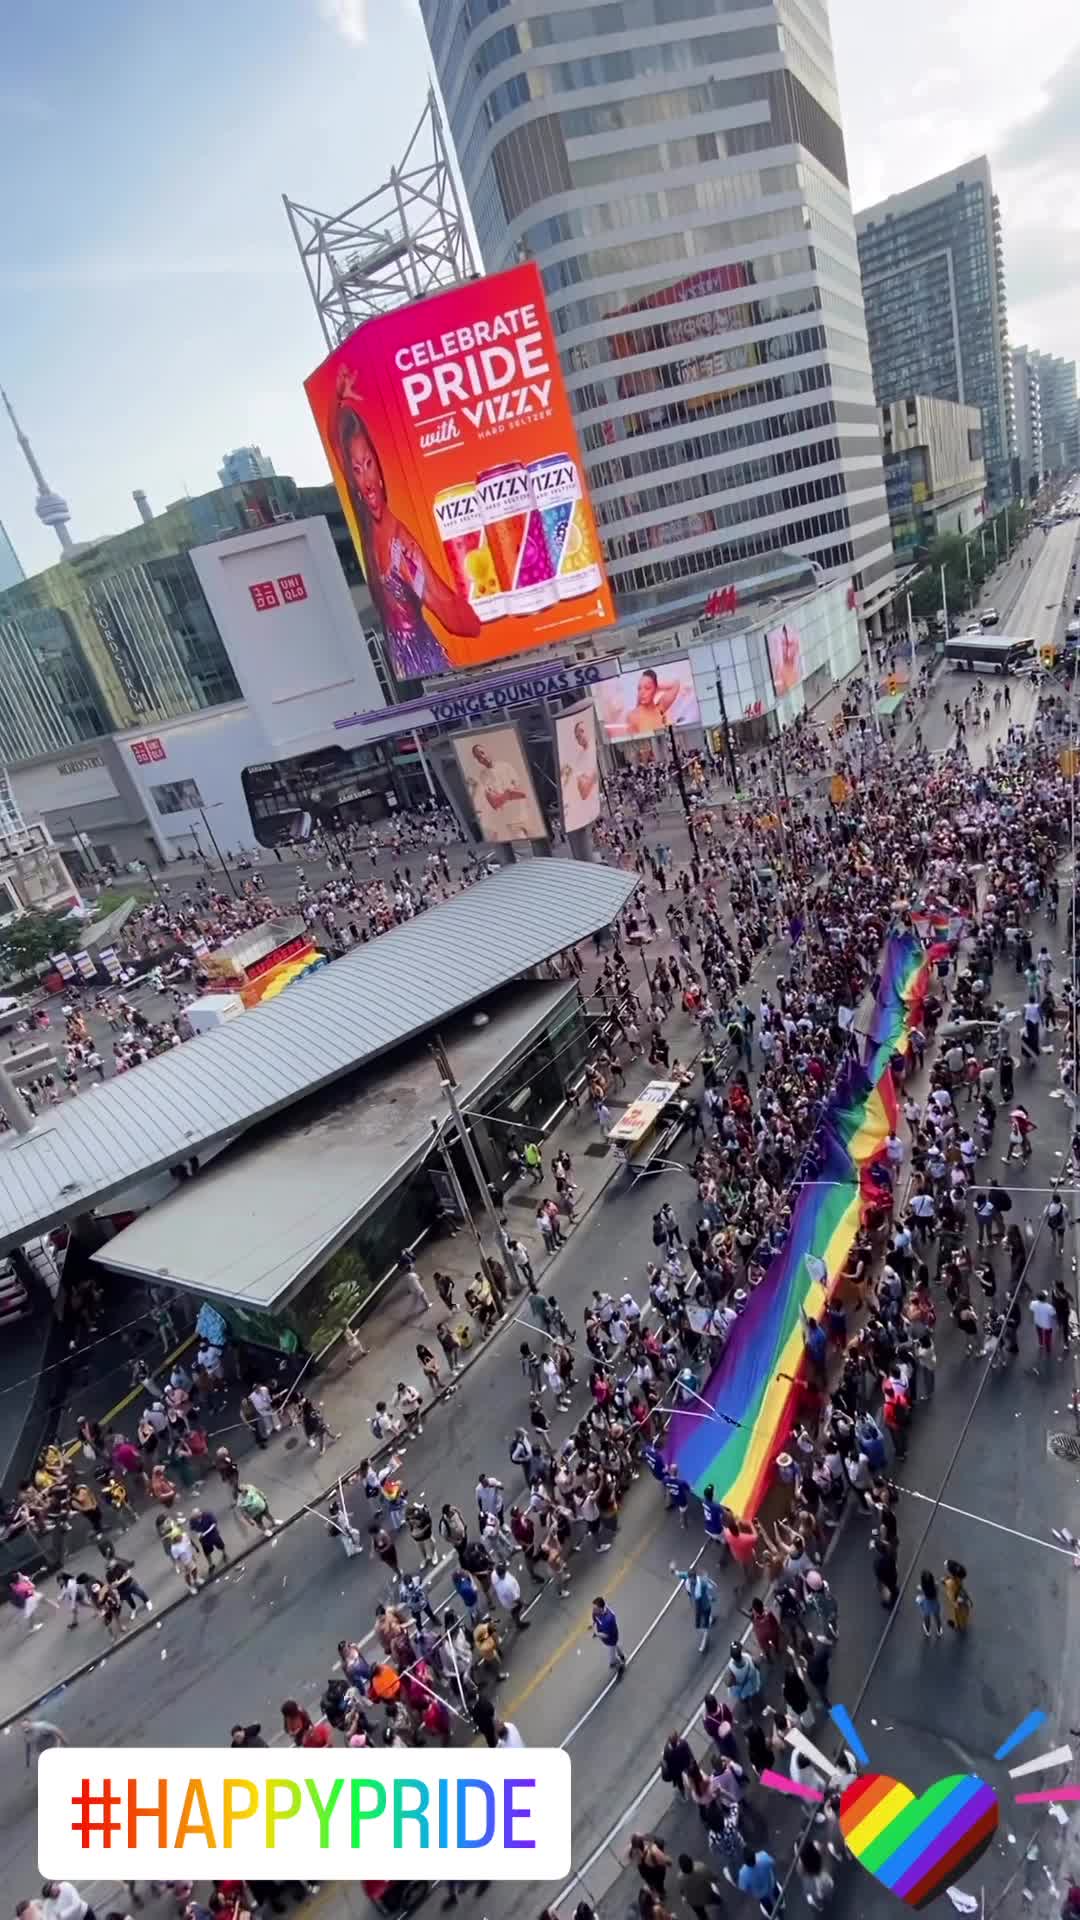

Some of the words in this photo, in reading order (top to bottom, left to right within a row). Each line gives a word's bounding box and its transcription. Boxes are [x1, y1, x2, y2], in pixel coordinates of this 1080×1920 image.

[395, 303, 540, 372] CELEBRATE
[401, 331, 550, 417] PRIDE
[419, 416, 461, 449] with
[461, 379, 552, 429] VIZZY
[478, 474, 529, 504] VIZZY
[280, 576, 299, 590] UNI
[285, 586, 304, 600] QLO
[429, 671, 569, 723] YONGE-DUNDAS
[574, 665, 601, 686] SQ
